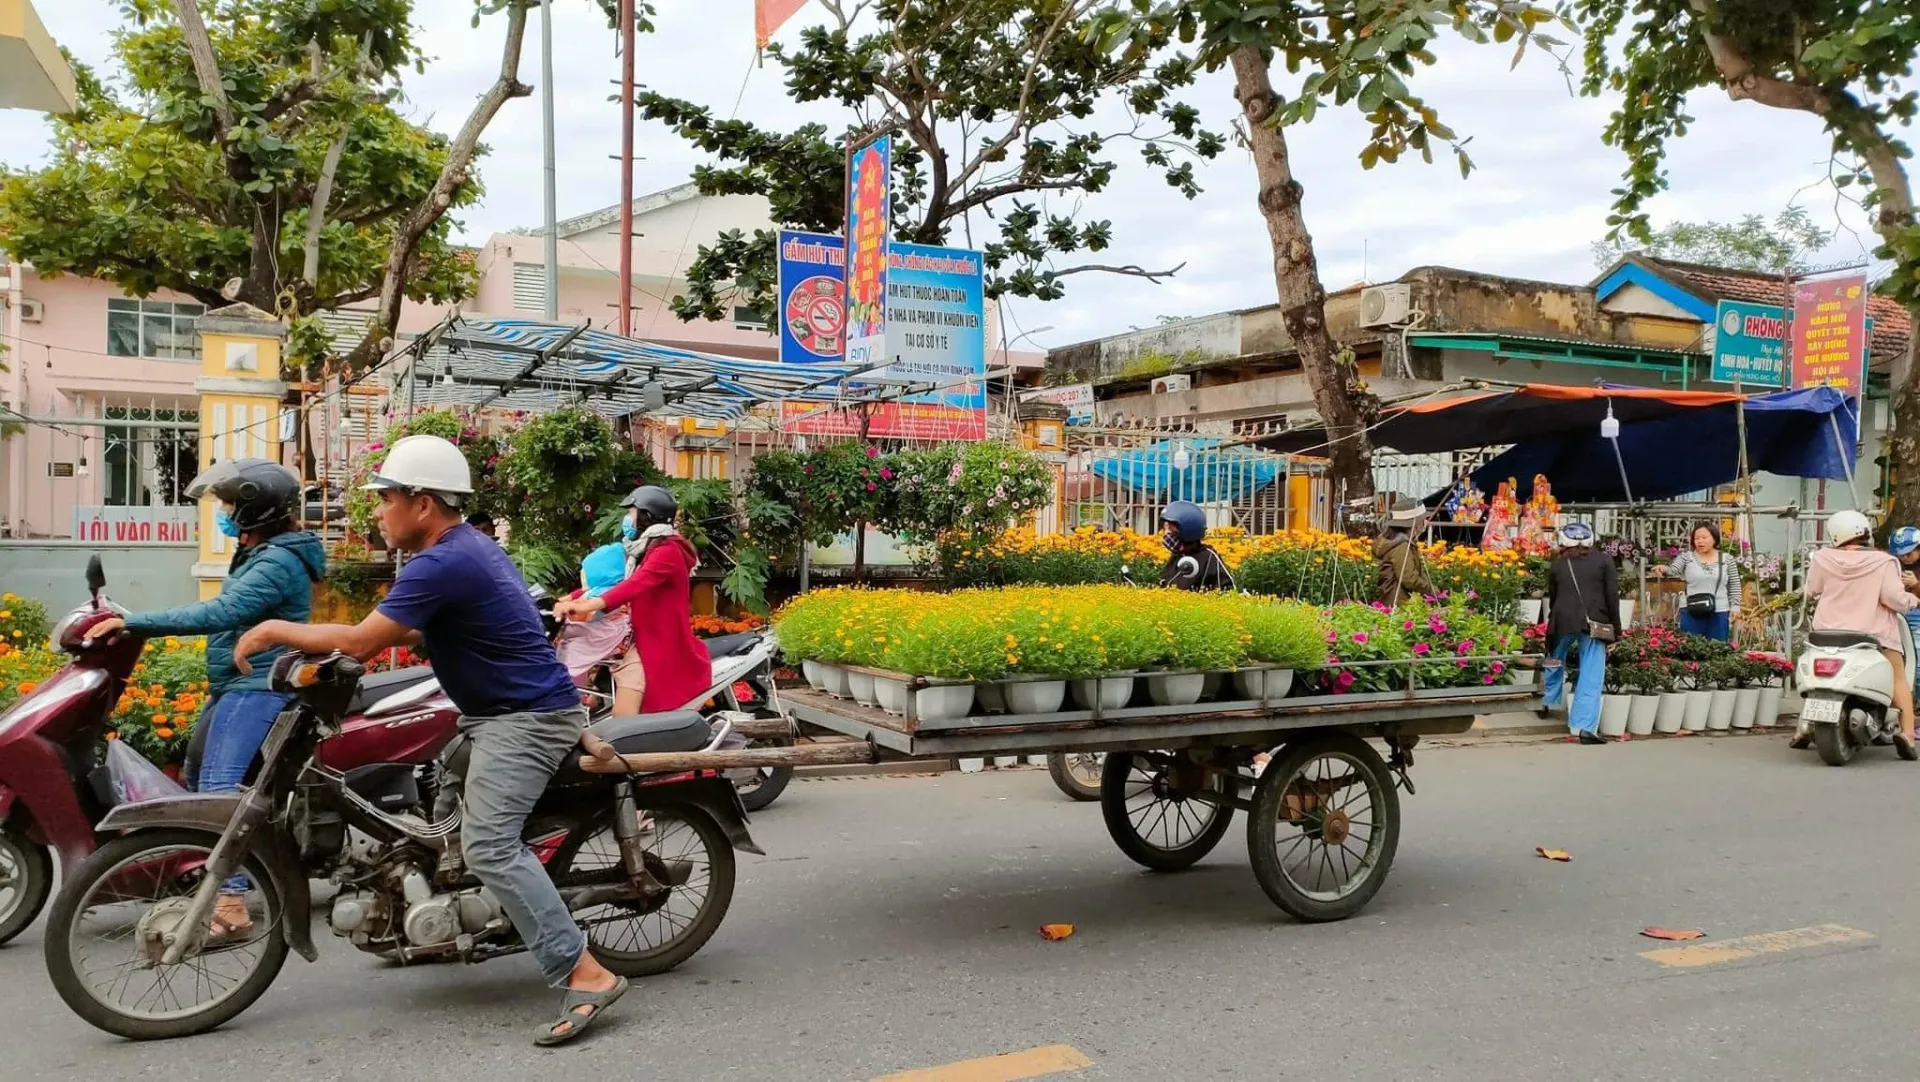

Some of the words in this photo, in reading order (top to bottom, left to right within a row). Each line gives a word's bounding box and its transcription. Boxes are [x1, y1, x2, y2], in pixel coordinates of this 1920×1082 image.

[783, 237, 807, 263] CẤM
[828, 247, 845, 267] THU
[917, 309, 936, 327] PHẠM
[936, 311, 943, 325] VI
[905, 333, 915, 351] TẠI
[935, 335, 940, 348] Y
[1828, 365, 1841, 376] AN
[115, 516, 151, 541] VÀO
